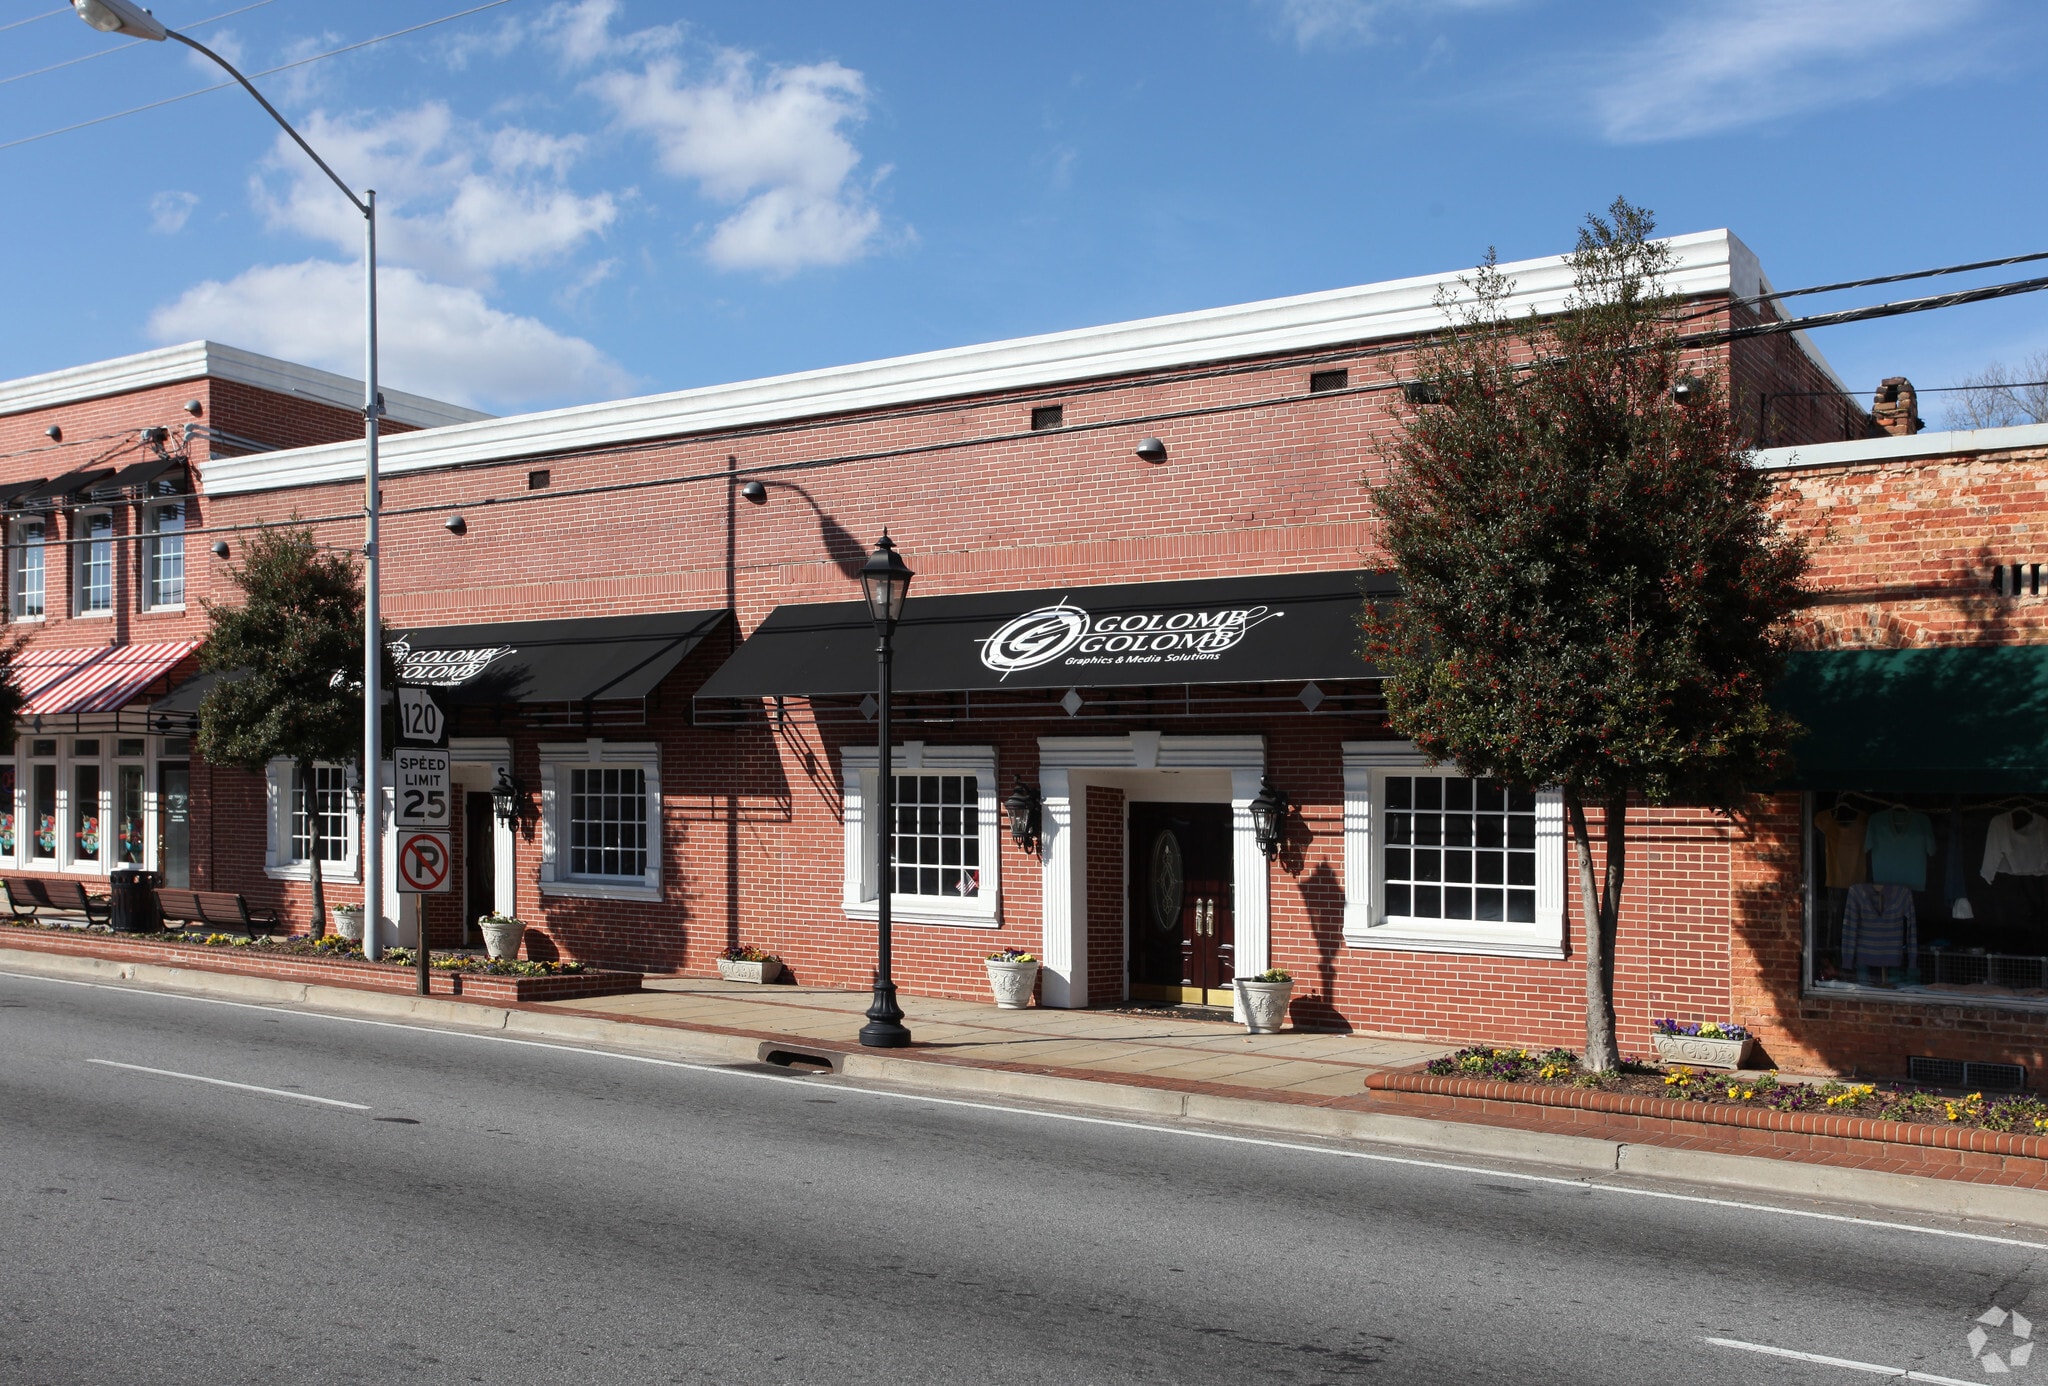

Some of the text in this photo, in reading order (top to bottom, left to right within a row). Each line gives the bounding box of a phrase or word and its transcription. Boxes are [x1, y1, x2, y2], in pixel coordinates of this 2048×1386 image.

[1094, 610, 1248, 631] GOLOMB
[1079, 631, 1234, 652] GOLOMB
[406, 647, 498, 663] GOLOMB
[1064, 652, 1222, 666] Graphics & Media Solutions
[396, 663, 480, 679] OLOMB
[403, 703, 436, 734] 120
[400, 757, 446, 771] SPEED
[405, 773, 441, 787] LIMIT
[403, 789, 446, 819] 25
[415, 845, 440, 879] P
